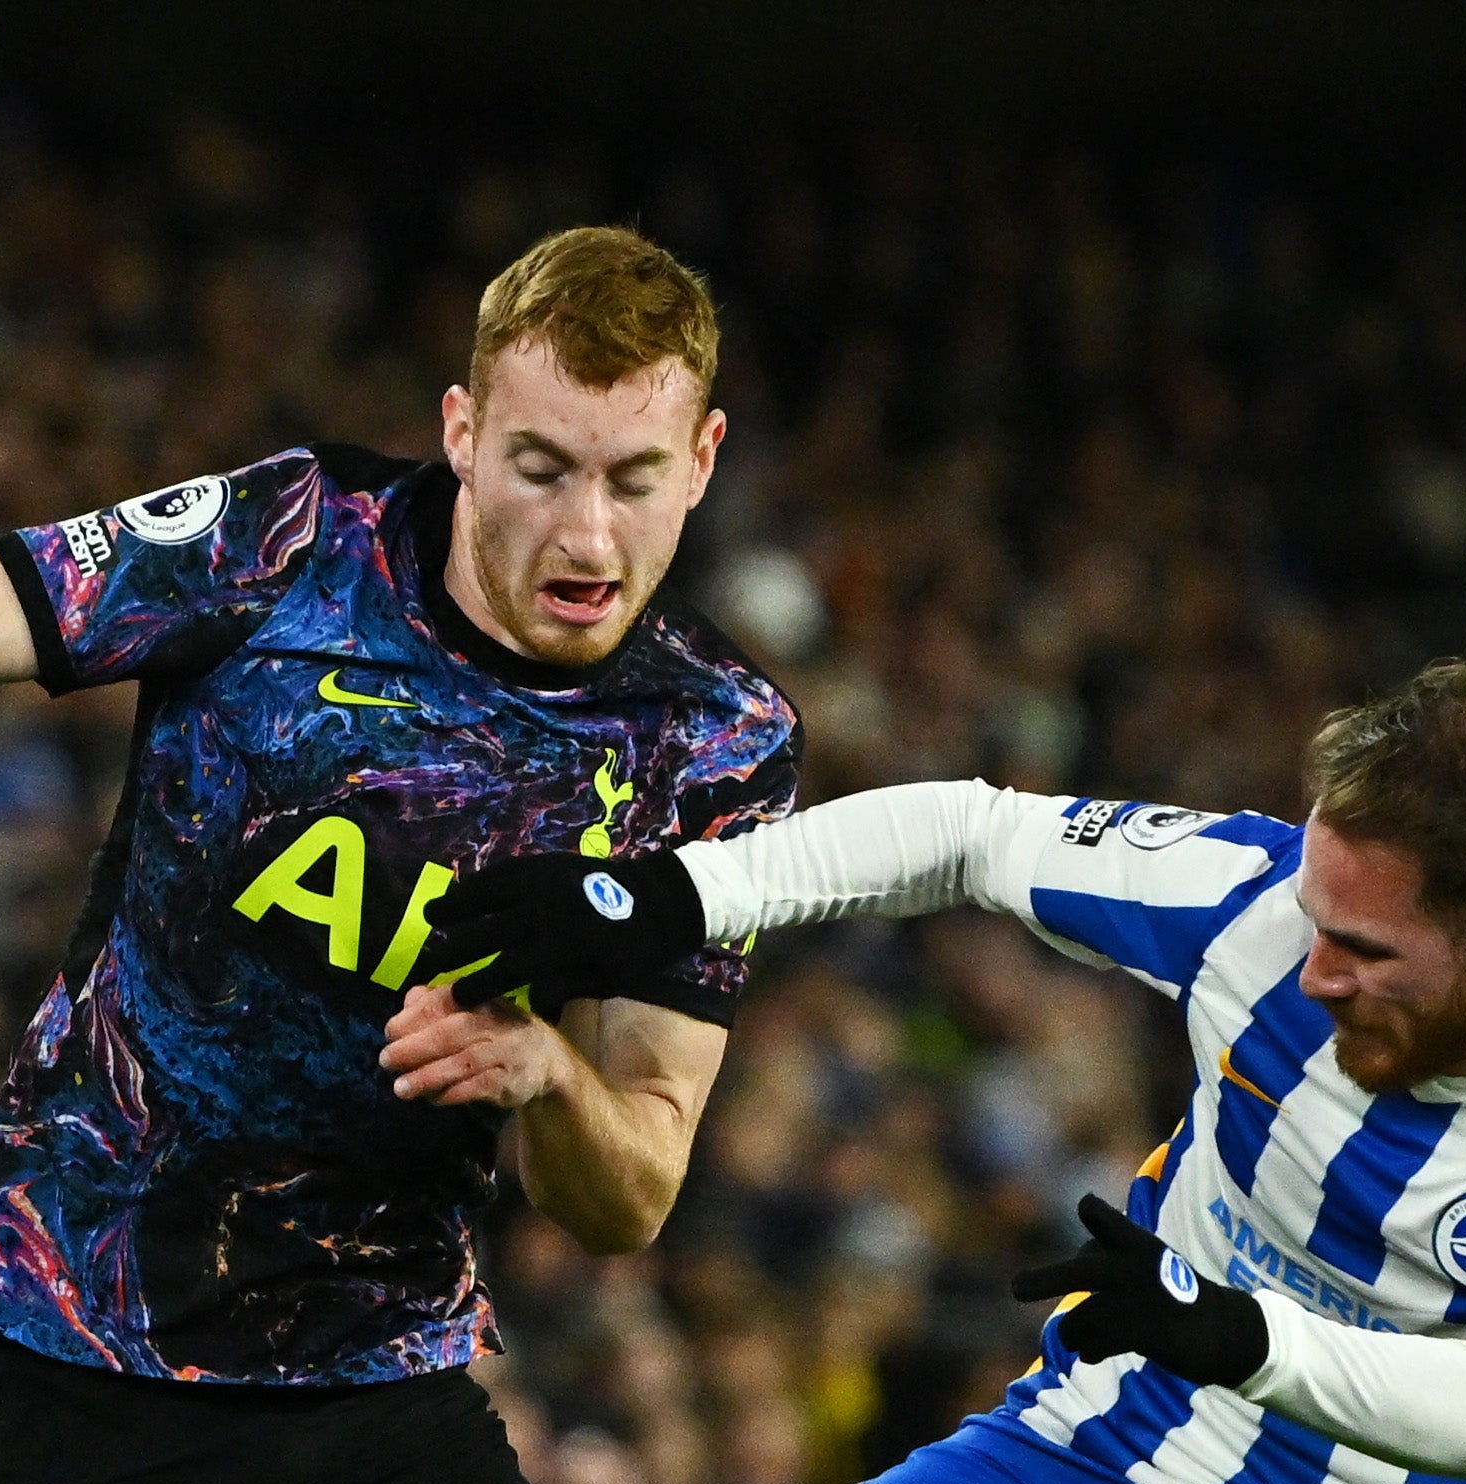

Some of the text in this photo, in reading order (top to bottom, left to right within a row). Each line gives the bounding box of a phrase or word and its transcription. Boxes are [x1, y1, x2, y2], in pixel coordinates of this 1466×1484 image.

[80, 514, 112, 563] oom
[1083, 800, 1120, 838] oom
[232, 815, 532, 1012] AI
